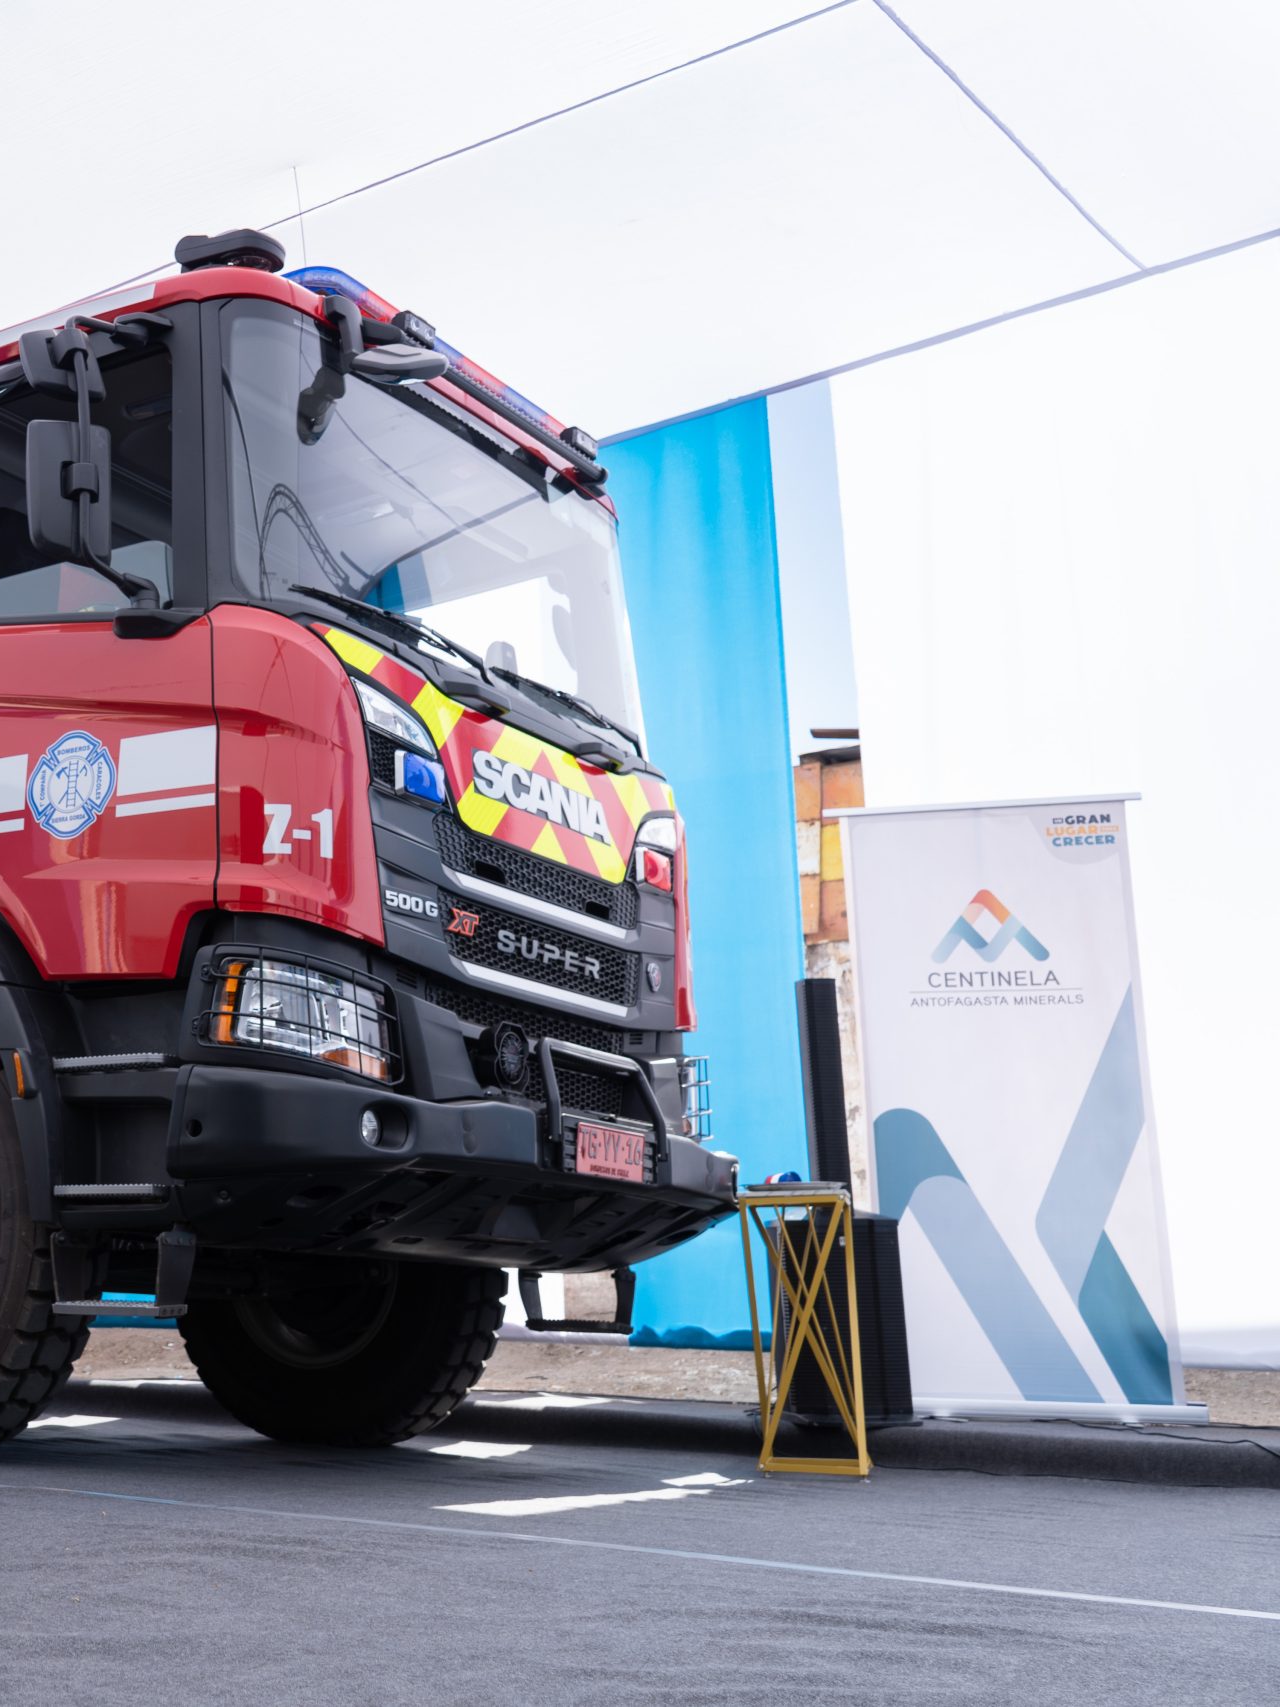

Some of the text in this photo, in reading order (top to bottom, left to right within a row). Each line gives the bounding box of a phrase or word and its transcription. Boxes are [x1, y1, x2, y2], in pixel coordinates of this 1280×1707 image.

[57, 745, 91, 756] BOMBEROS
[95, 761, 103, 800] CARACOLES
[472, 748, 612, 847] SCANIA
[1065, 814, 1112, 825] GRAN
[263, 803, 334, 860] Z-1
[1046, 825, 1098, 837] LUGAR
[1052, 834, 1116, 847] CRECER
[447, 907, 480, 937] XT
[496, 929, 601, 980] SUPER
[927, 969, 1061, 989] CENTINELA
[910, 993, 1085, 1008] ANTOFAGASTA MINERALS
